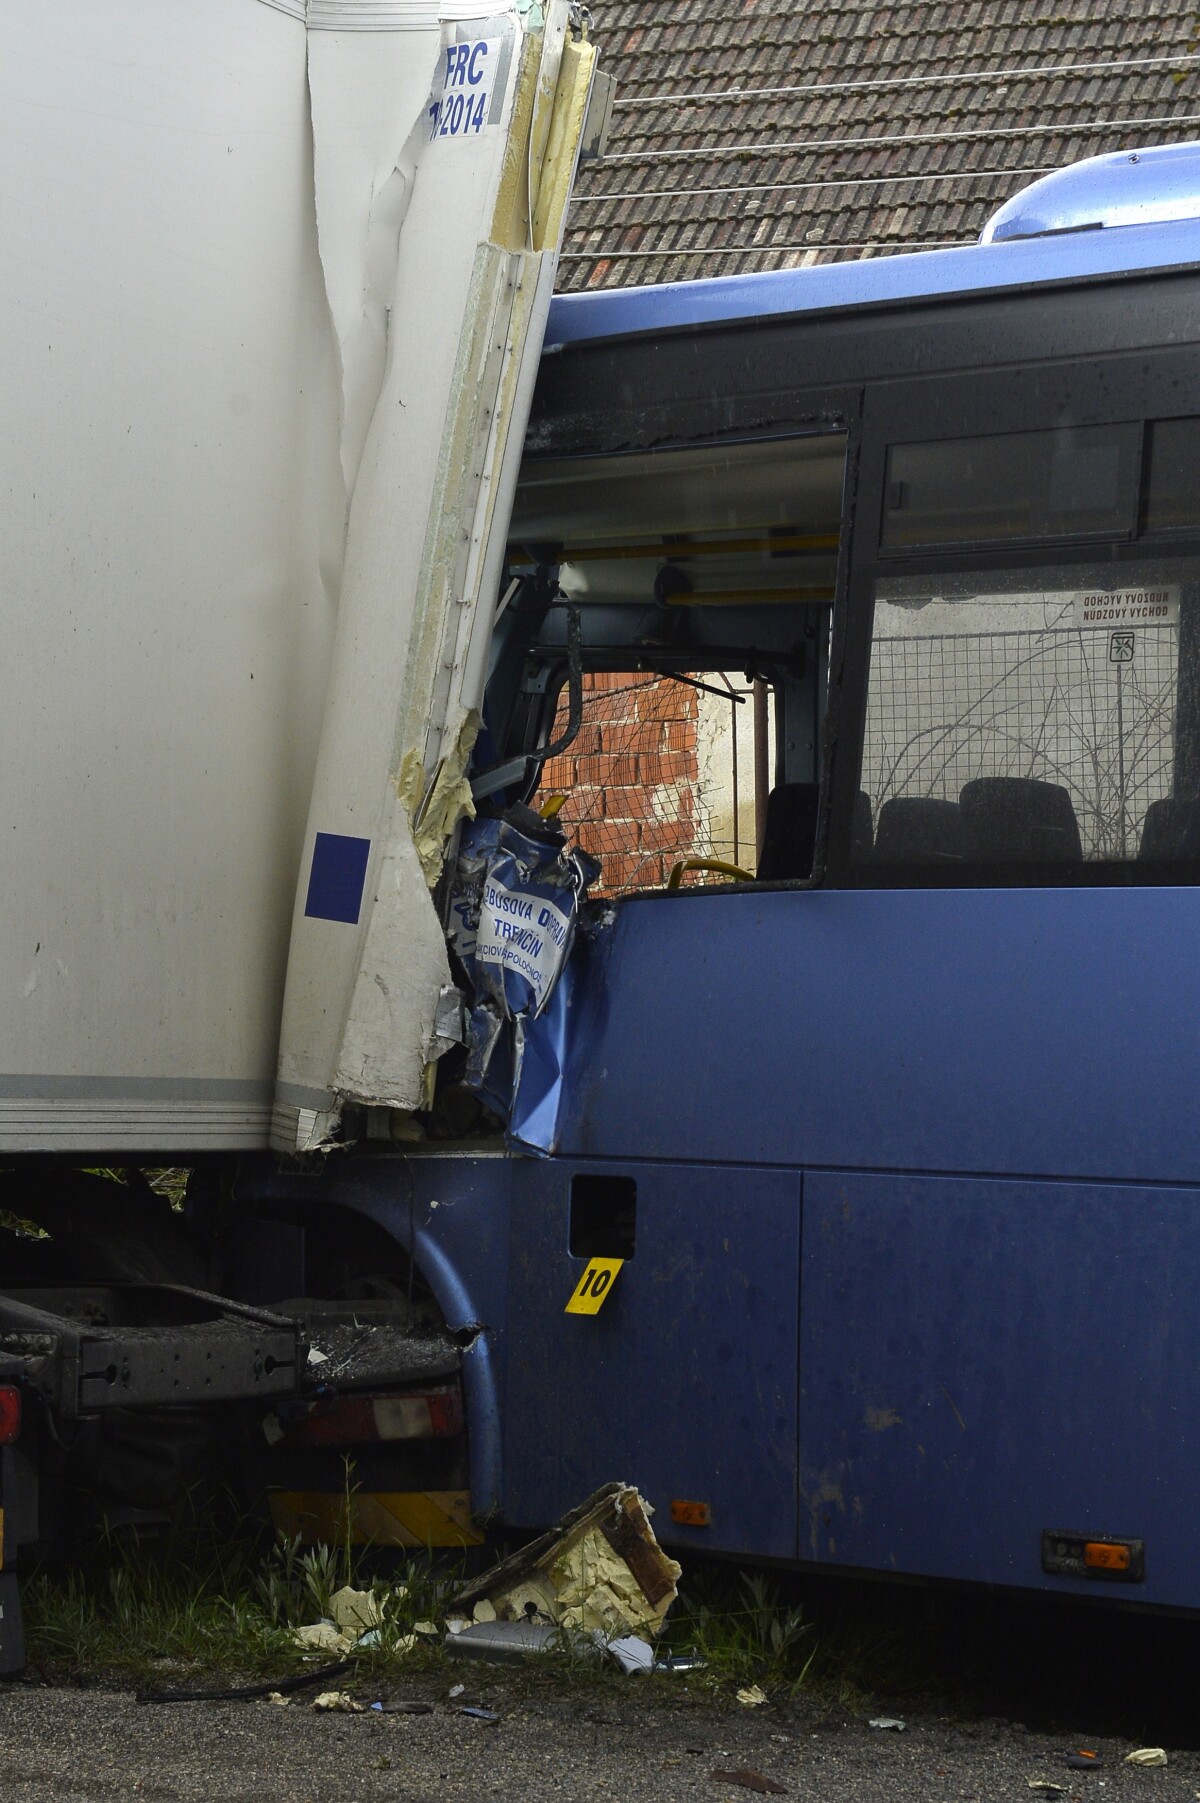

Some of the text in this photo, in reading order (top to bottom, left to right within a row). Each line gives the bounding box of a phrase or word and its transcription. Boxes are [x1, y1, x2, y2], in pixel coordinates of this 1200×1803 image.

[444, 42, 488, 89] FRC
[1083, 605, 1168, 620] NÚDZOVÝ VÝCHOD
[495, 918, 543, 958] TRENČÍN
[579, 1269, 611, 1298] 10
